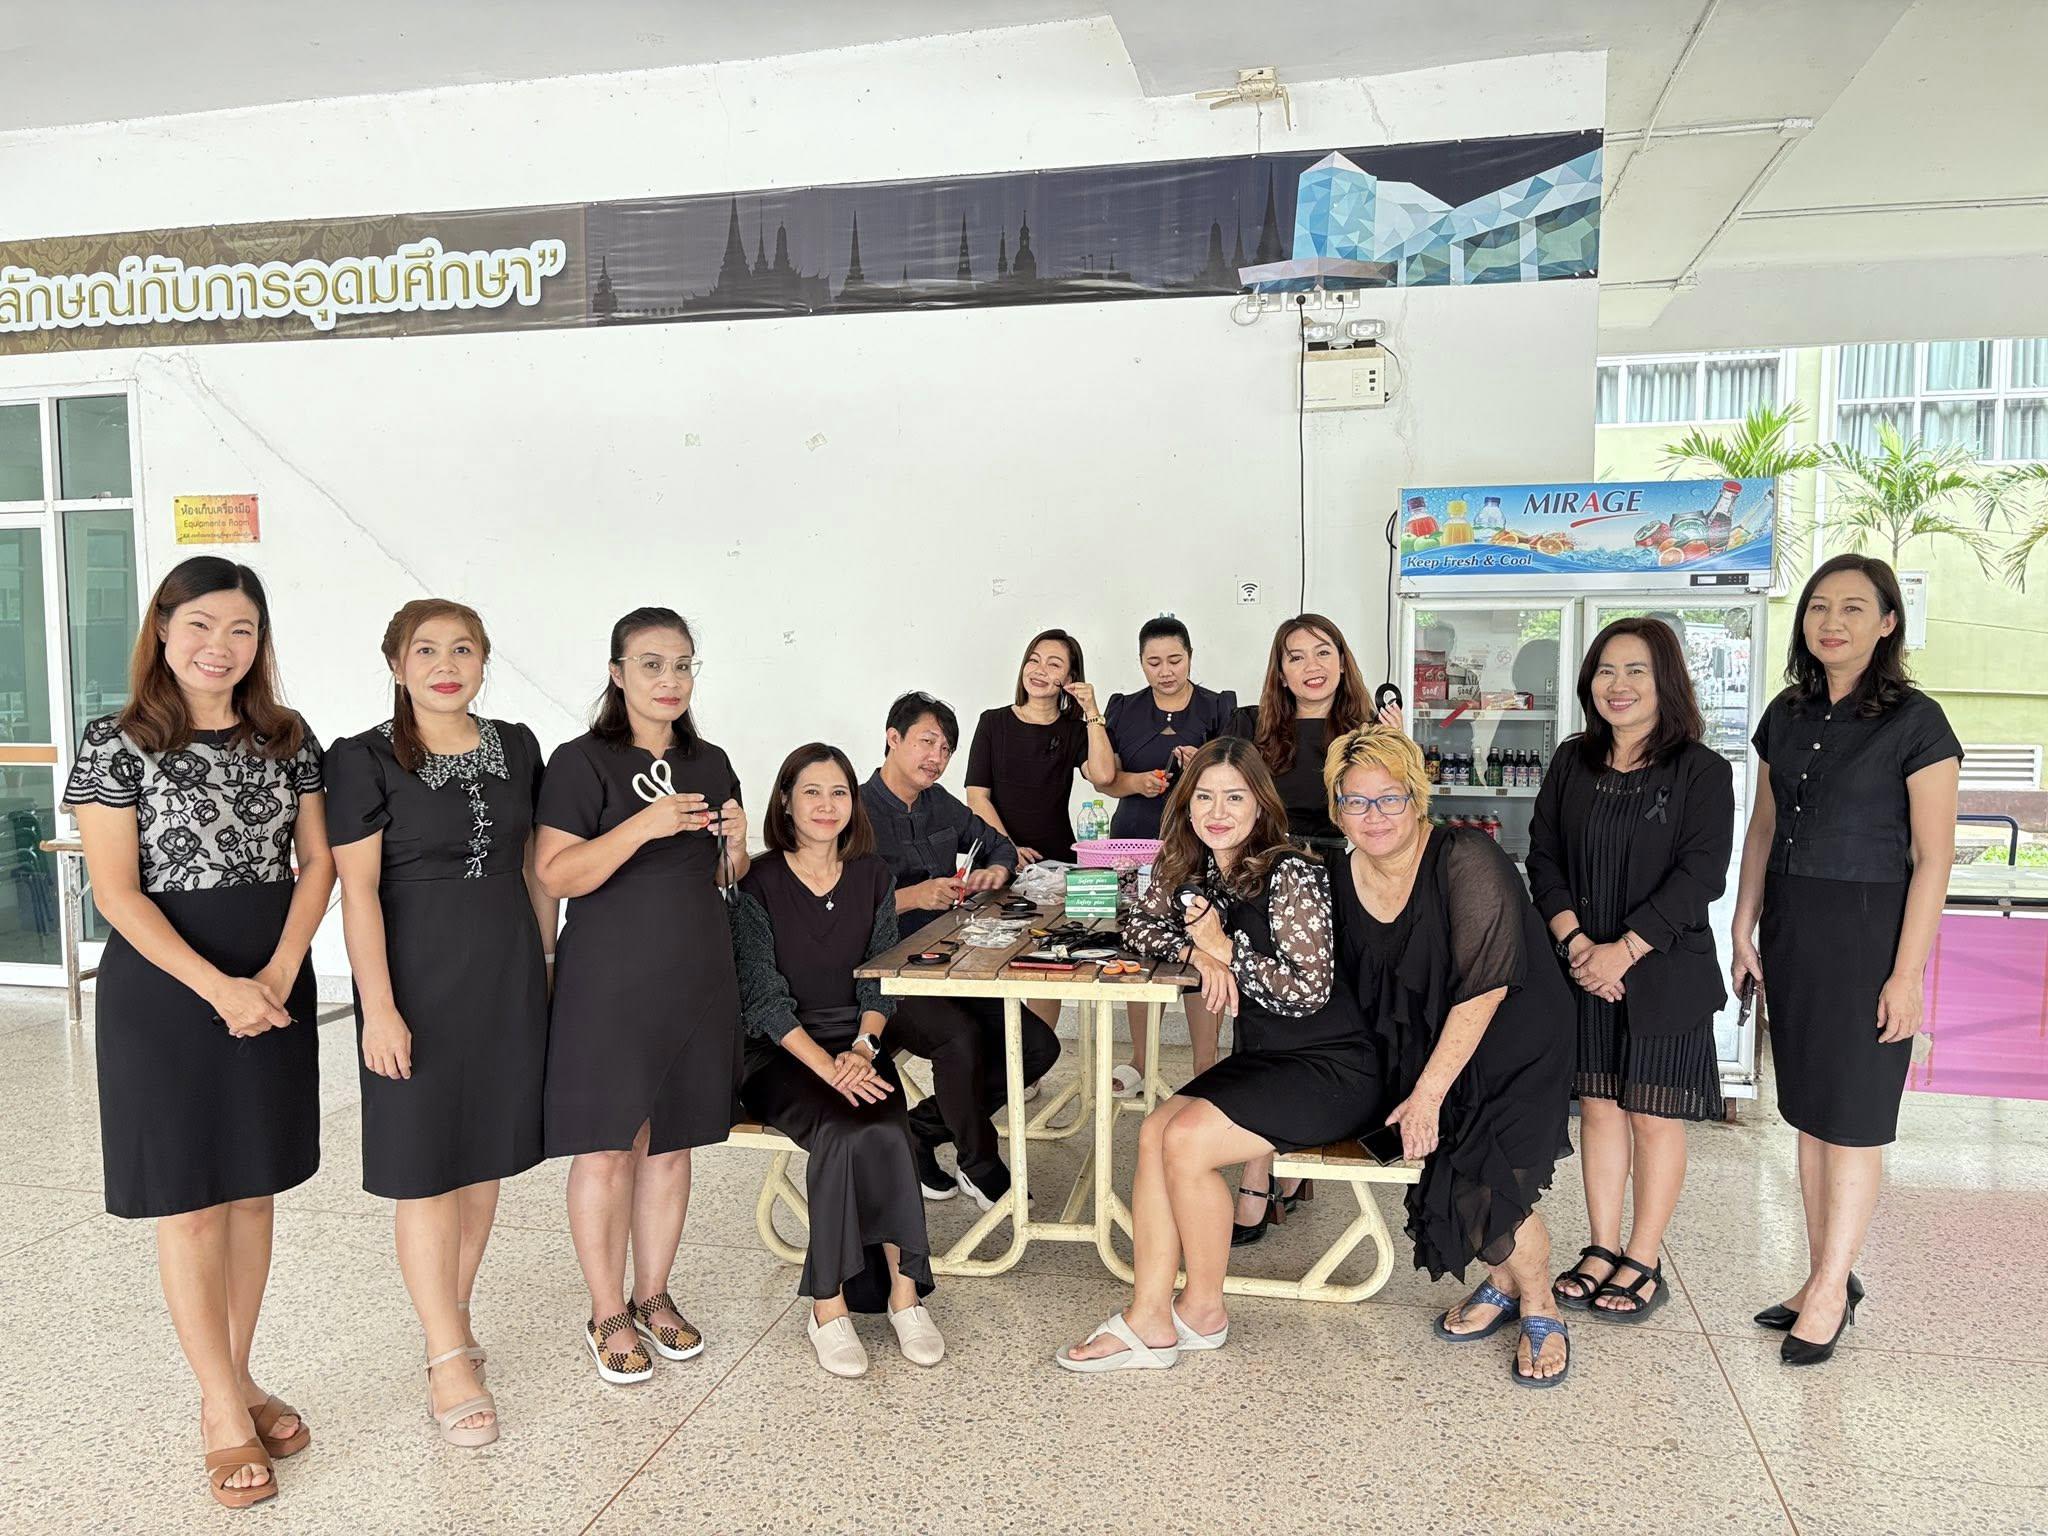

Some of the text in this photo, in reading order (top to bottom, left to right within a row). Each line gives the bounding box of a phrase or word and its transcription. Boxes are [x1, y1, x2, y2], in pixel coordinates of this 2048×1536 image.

[180, 501, 251, 516] ห้องเก็บเครื่องมือ
[1523, 490, 1644, 514] MIRAGE
[228, 518, 250, 527] Room
[1407, 554, 1532, 569] Keep Fresh & Cool
